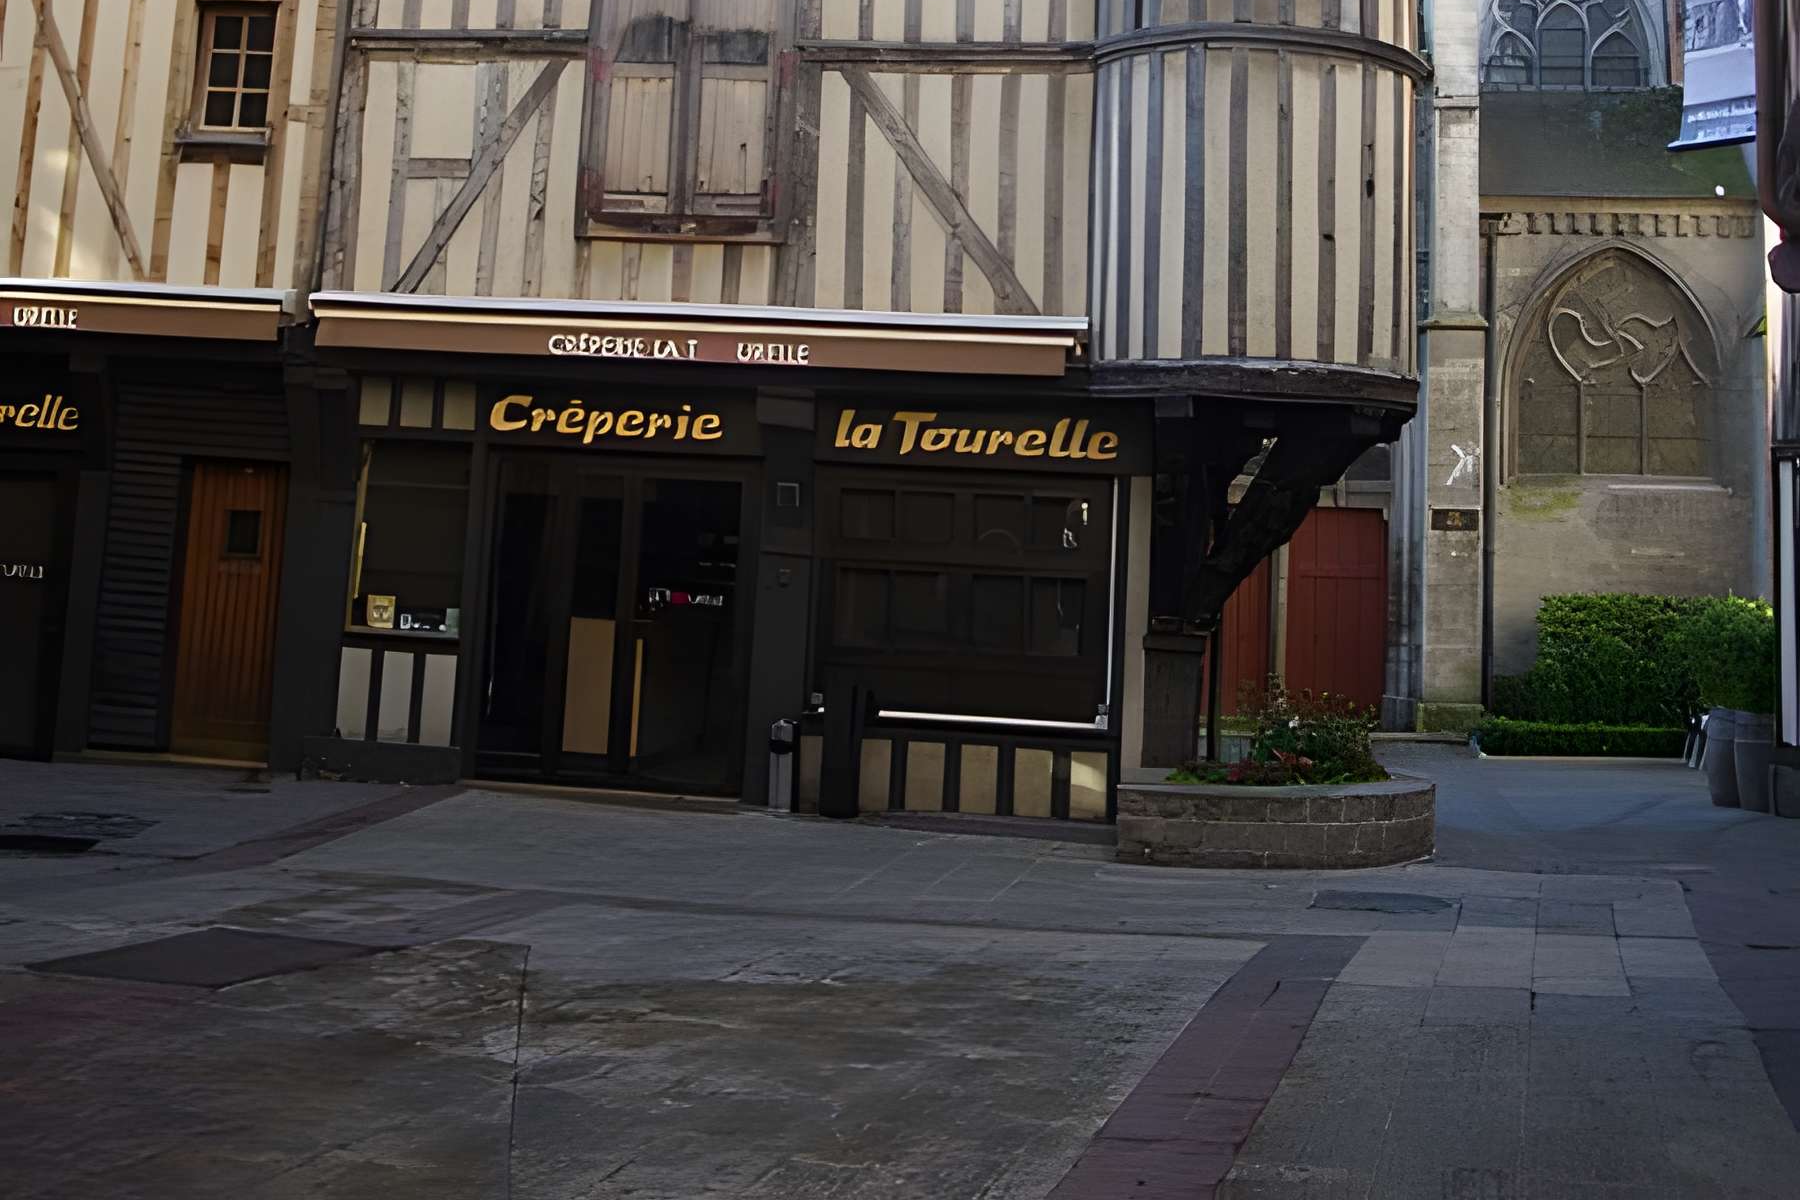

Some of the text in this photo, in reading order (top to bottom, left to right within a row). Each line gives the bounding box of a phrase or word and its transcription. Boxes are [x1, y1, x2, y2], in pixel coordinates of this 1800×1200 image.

[489, 395, 723, 444] Crêperie
[835, 409, 1119, 461] la Tourelle
